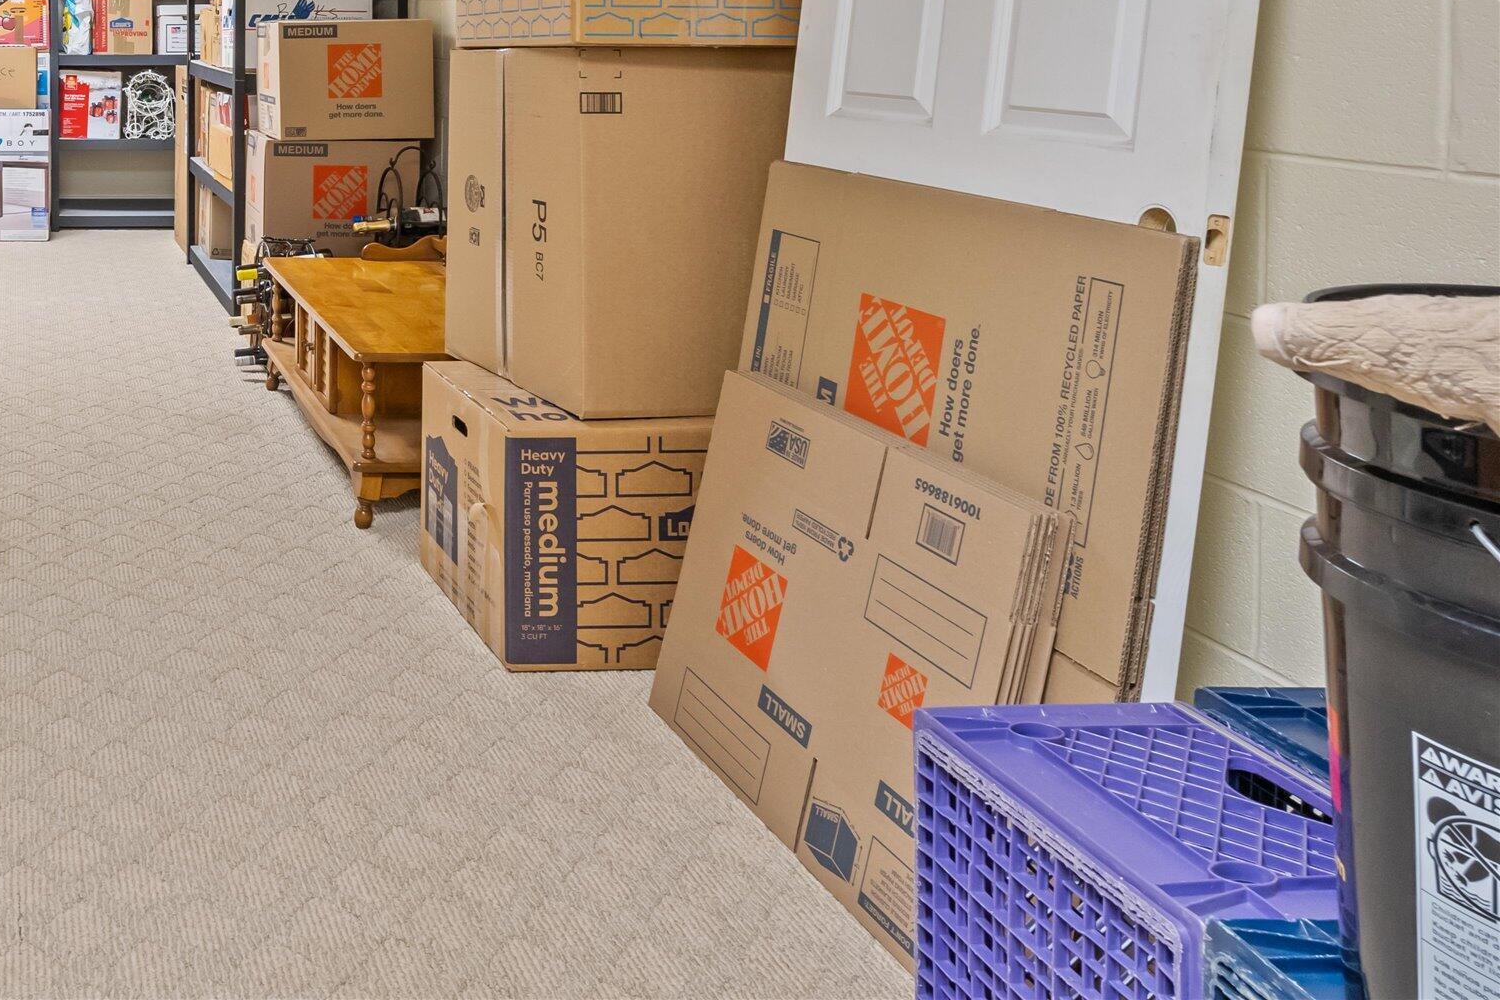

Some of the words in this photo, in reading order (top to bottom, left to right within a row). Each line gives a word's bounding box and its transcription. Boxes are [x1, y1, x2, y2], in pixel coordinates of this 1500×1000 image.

[288, 27, 333, 36] MEDIUM
[329, 44, 381, 98] HOME
[334, 50, 354, 71] THE
[350, 63, 381, 97] DEPOT
[278, 146, 324, 154] MEDIUM
[313, 167, 367, 218] HOME
[320, 172, 340, 192] THE
[532, 199, 547, 242] P5
[535, 252, 544, 281] BC7
[765, 252, 776, 293] FRAGILE
[1072, 275, 1086, 321] PAPER
[1095, 311, 1104, 343] MILLION
[890, 306, 937, 393] DEPOT
[965, 324, 981, 374] done.
[1060, 324, 1079, 400] RECYCLED
[859, 296, 931, 439] HOME
[859, 356, 888, 413] THE
[939, 396, 954, 437] How
[948, 339, 963, 391] doers
[957, 381, 972, 428] more
[1083, 389, 1092, 422] MILLION
[1055, 404, 1067, 439] 100%
[521, 449, 565, 463] Heavy
[789, 434, 807, 457] USA
[952, 431, 964, 463] get
[1048, 443, 1062, 481] FROM
[429, 450, 449, 484] Heavy
[429, 468, 444, 495] Duty
[521, 463, 554, 476] Duty
[1073, 463, 1081, 499] MILLION
[524, 481, 533, 506] Para
[915, 477, 981, 520] 1006188665
[741, 512, 761, 530] done.
[762, 528, 781, 545] more
[523, 528, 533, 569] pesado,
[538, 481, 567, 617] medium
[745, 531, 767, 549] doers
[767, 545, 785, 565] How
[783, 538, 797, 555] get
[524, 571, 534, 617] mediana
[1071, 557, 1084, 600] ACTIONS
[719, 573, 784, 638] HOME
[766, 693, 806, 739] SMALL
[1432, 901, 1474, 930] Children
[1478, 929, 1499, 942] can
